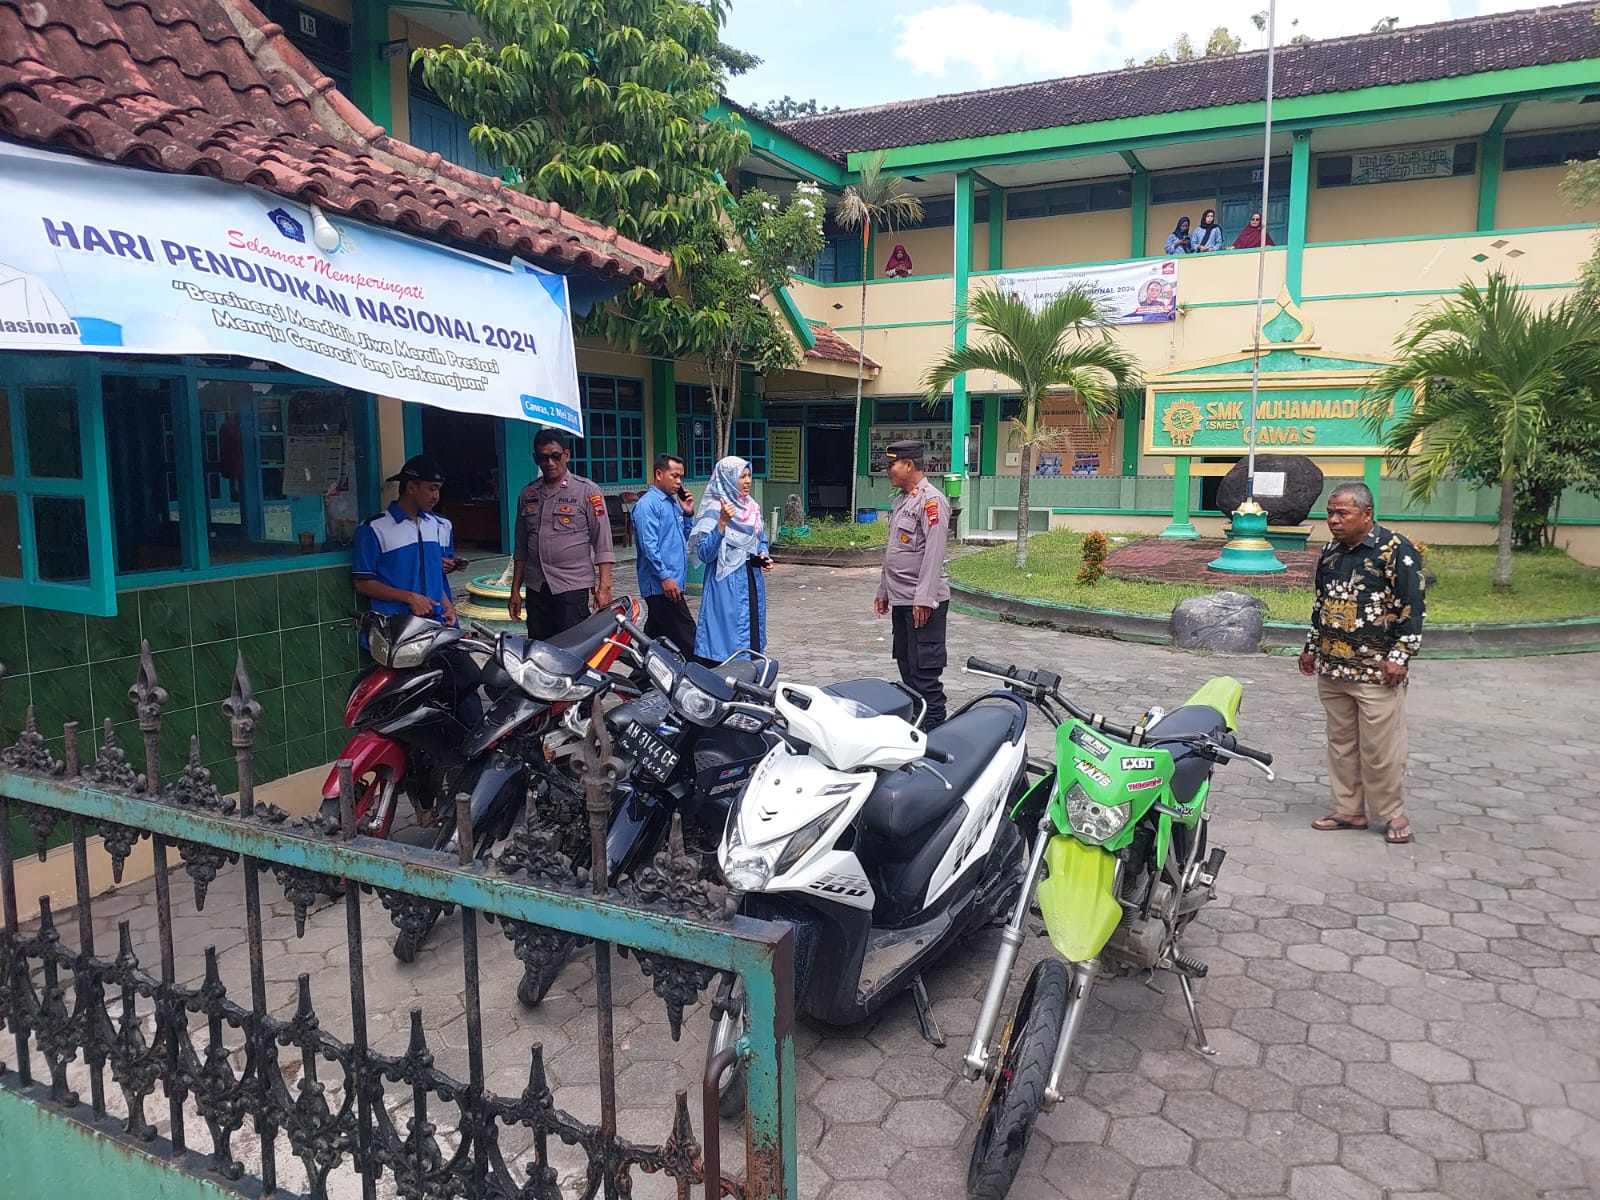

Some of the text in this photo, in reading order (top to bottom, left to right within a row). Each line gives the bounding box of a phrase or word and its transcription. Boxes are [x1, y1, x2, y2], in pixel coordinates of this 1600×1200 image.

[42, 217, 537, 354] HARI PENDIDIKAN NASIONAL 2024
[227, 230, 424, 300] Selamat Memperingati
[212, 308, 286, 343] Menuju
[287, 329, 356, 365] Generasi
[356, 350, 394, 378] Yang
[286, 306, 356, 344] Mendidik
[356, 332, 393, 355] Jiwa
[394, 340, 446, 366] Meraih
[448, 351, 500, 374] Prestasi
[1206, 401, 1244, 420] SMK
[1243, 426, 1317, 445] CAWAS
